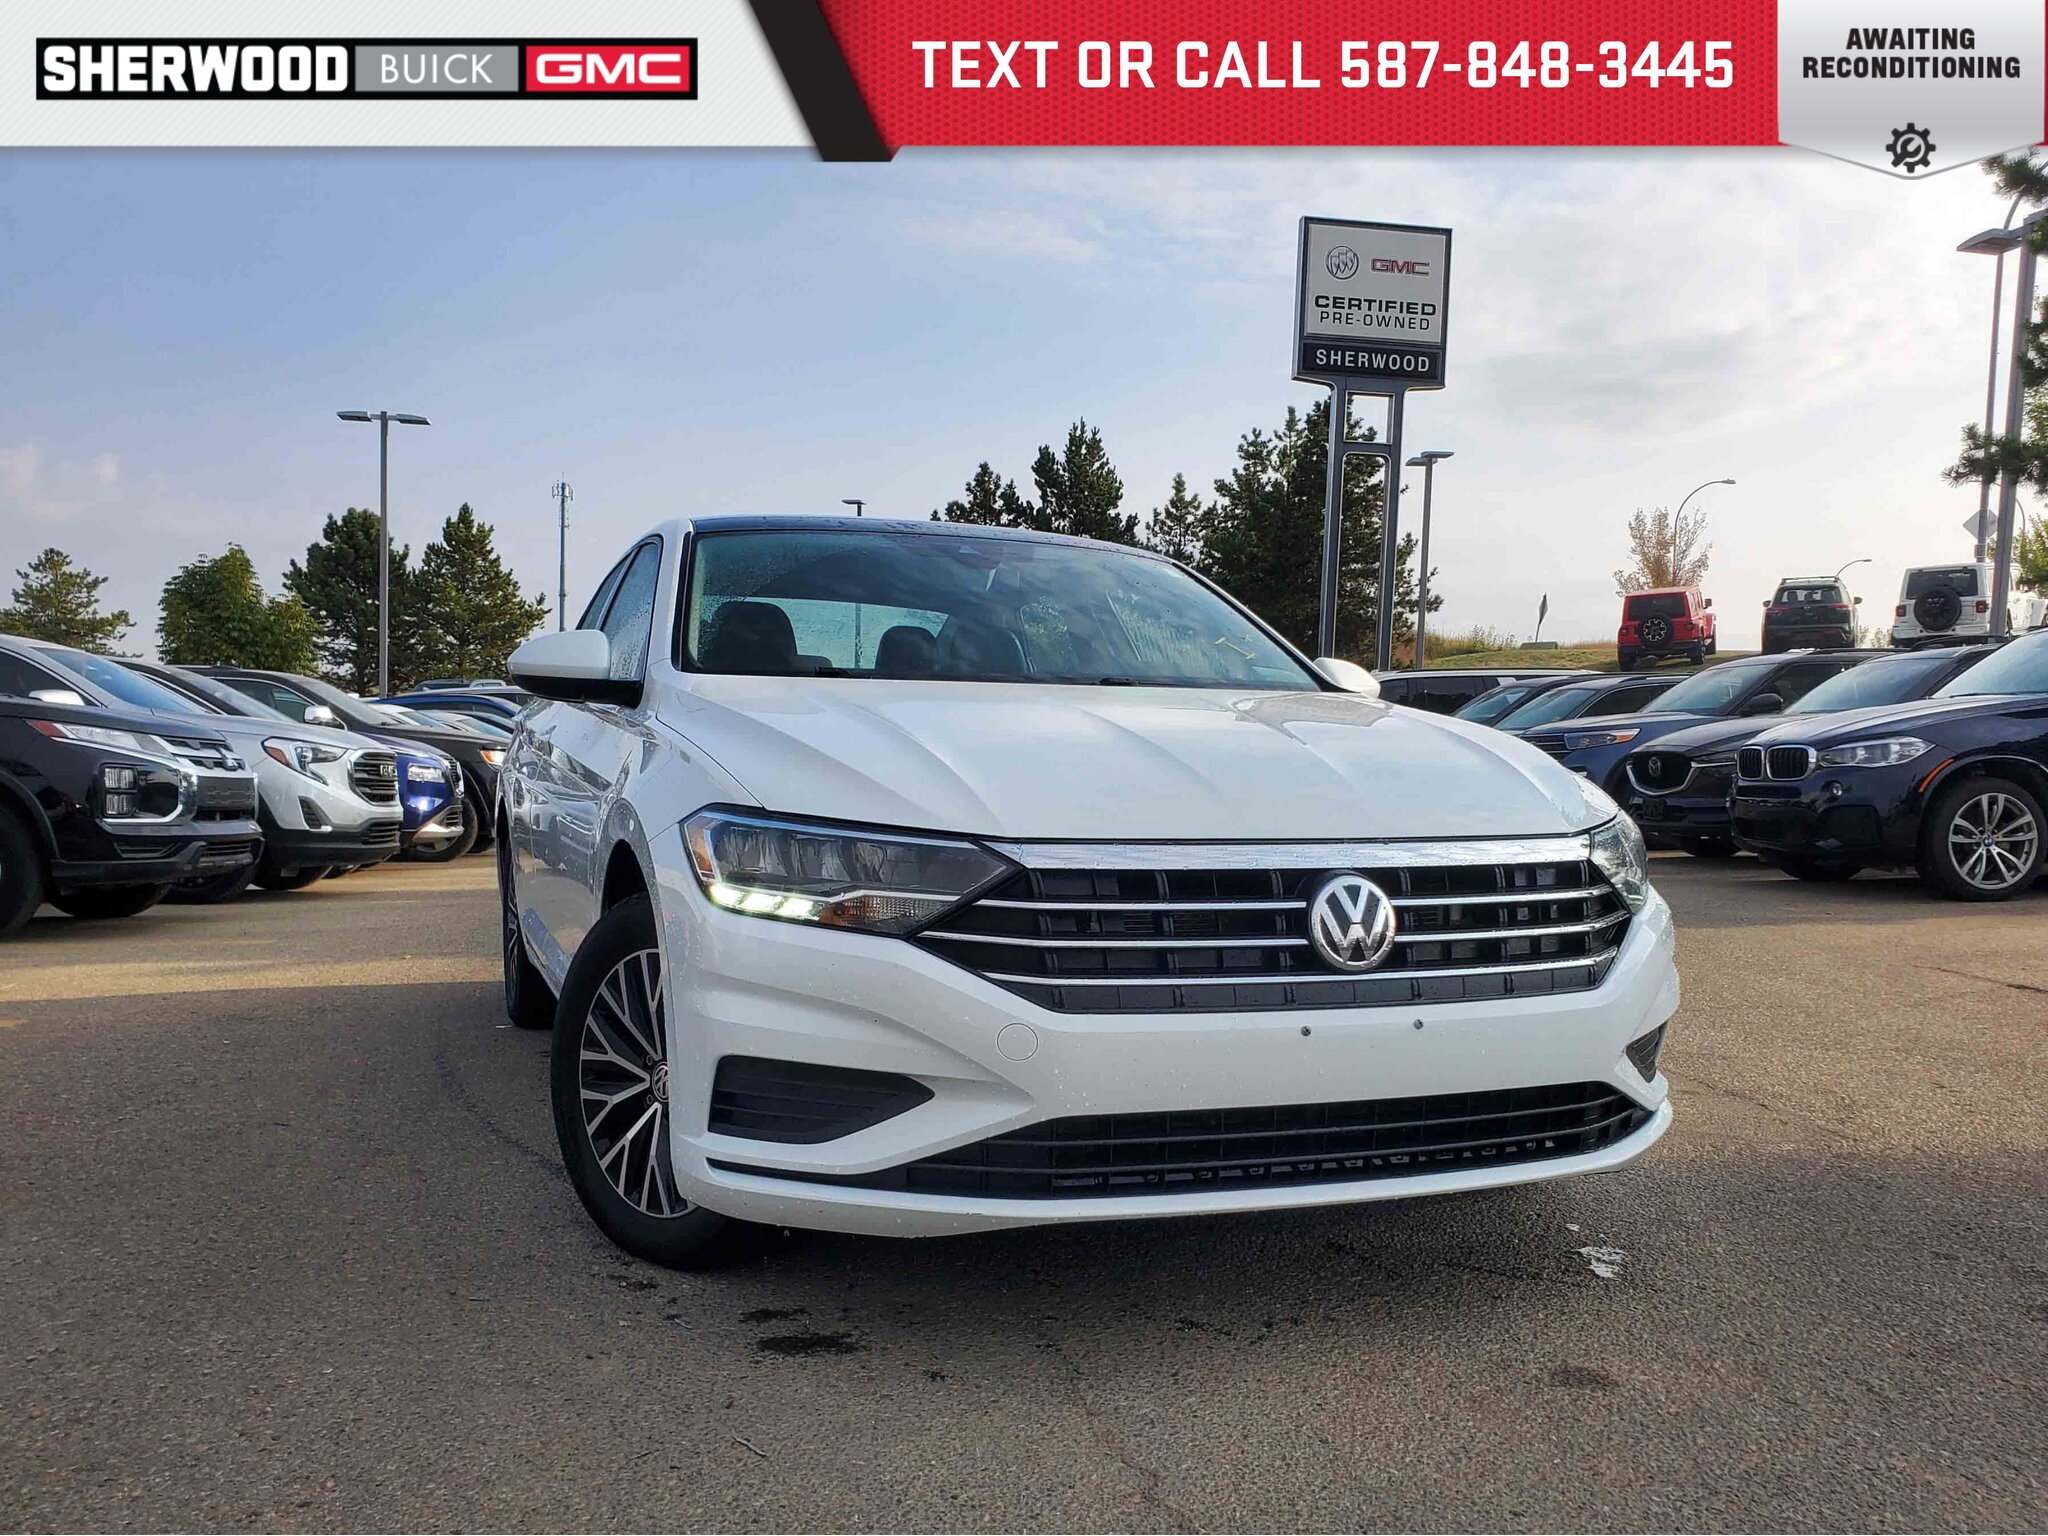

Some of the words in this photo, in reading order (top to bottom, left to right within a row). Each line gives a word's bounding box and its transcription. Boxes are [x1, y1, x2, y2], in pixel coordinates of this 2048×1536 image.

[1371, 258, 1430, 276] GMC
[1314, 295, 1437, 316] CERTIFIED
[1319, 310, 1430, 331] PRE-OWNED
[1316, 349, 1430, 372] SHERWOOD
